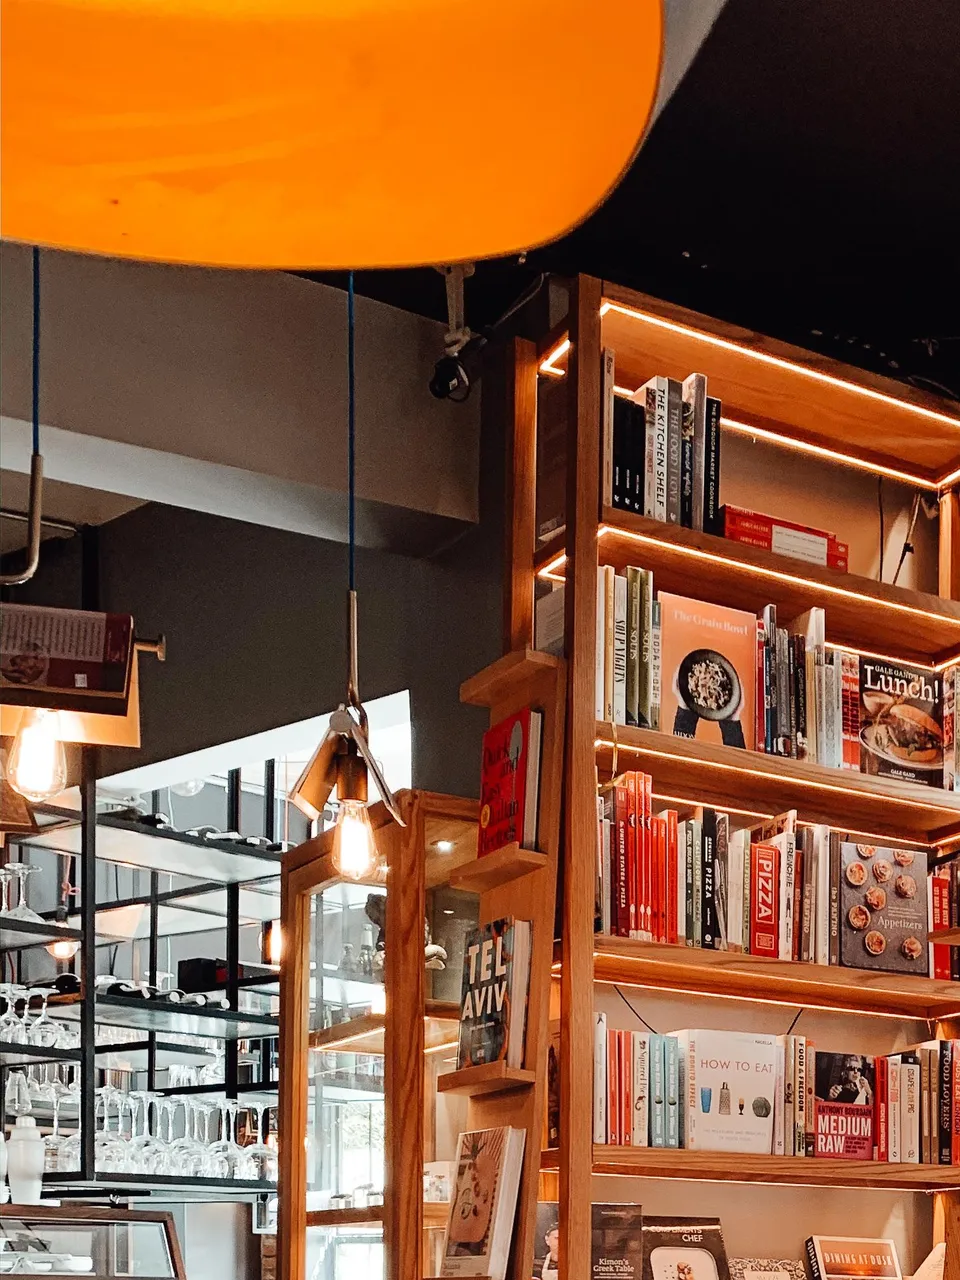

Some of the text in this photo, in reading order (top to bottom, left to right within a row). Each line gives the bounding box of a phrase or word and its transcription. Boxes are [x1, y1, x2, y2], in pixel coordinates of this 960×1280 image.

[656, 388, 666, 507] THE KITCHEN SHELF
[669, 407, 680, 466] THE FOOD
[693, 614, 748, 636] Grain Bowl
[874, 665, 894, 675] GALE
[864, 664, 939, 704] Lunch!
[758, 860, 772, 918] PIZZA
[877, 915, 923, 931] Appetizers
[468, 936, 506, 986] TEL
[462, 981, 507, 1022] AVIV
[700, 1059, 773, 1074] HOW TO EAT
[942, 1050, 952, 1132] FOOD LOVERS'
[817, 1114, 872, 1136] MEDIUM
[817, 1134, 845, 1153] RAW
[682, 1234, 704, 1243] CHEF
[593, 1265, 634, 1273] Greek Table
[599, 1258, 629, 1266] Kimon's
[824, 1251, 893, 1267] DINING AT DUSK
